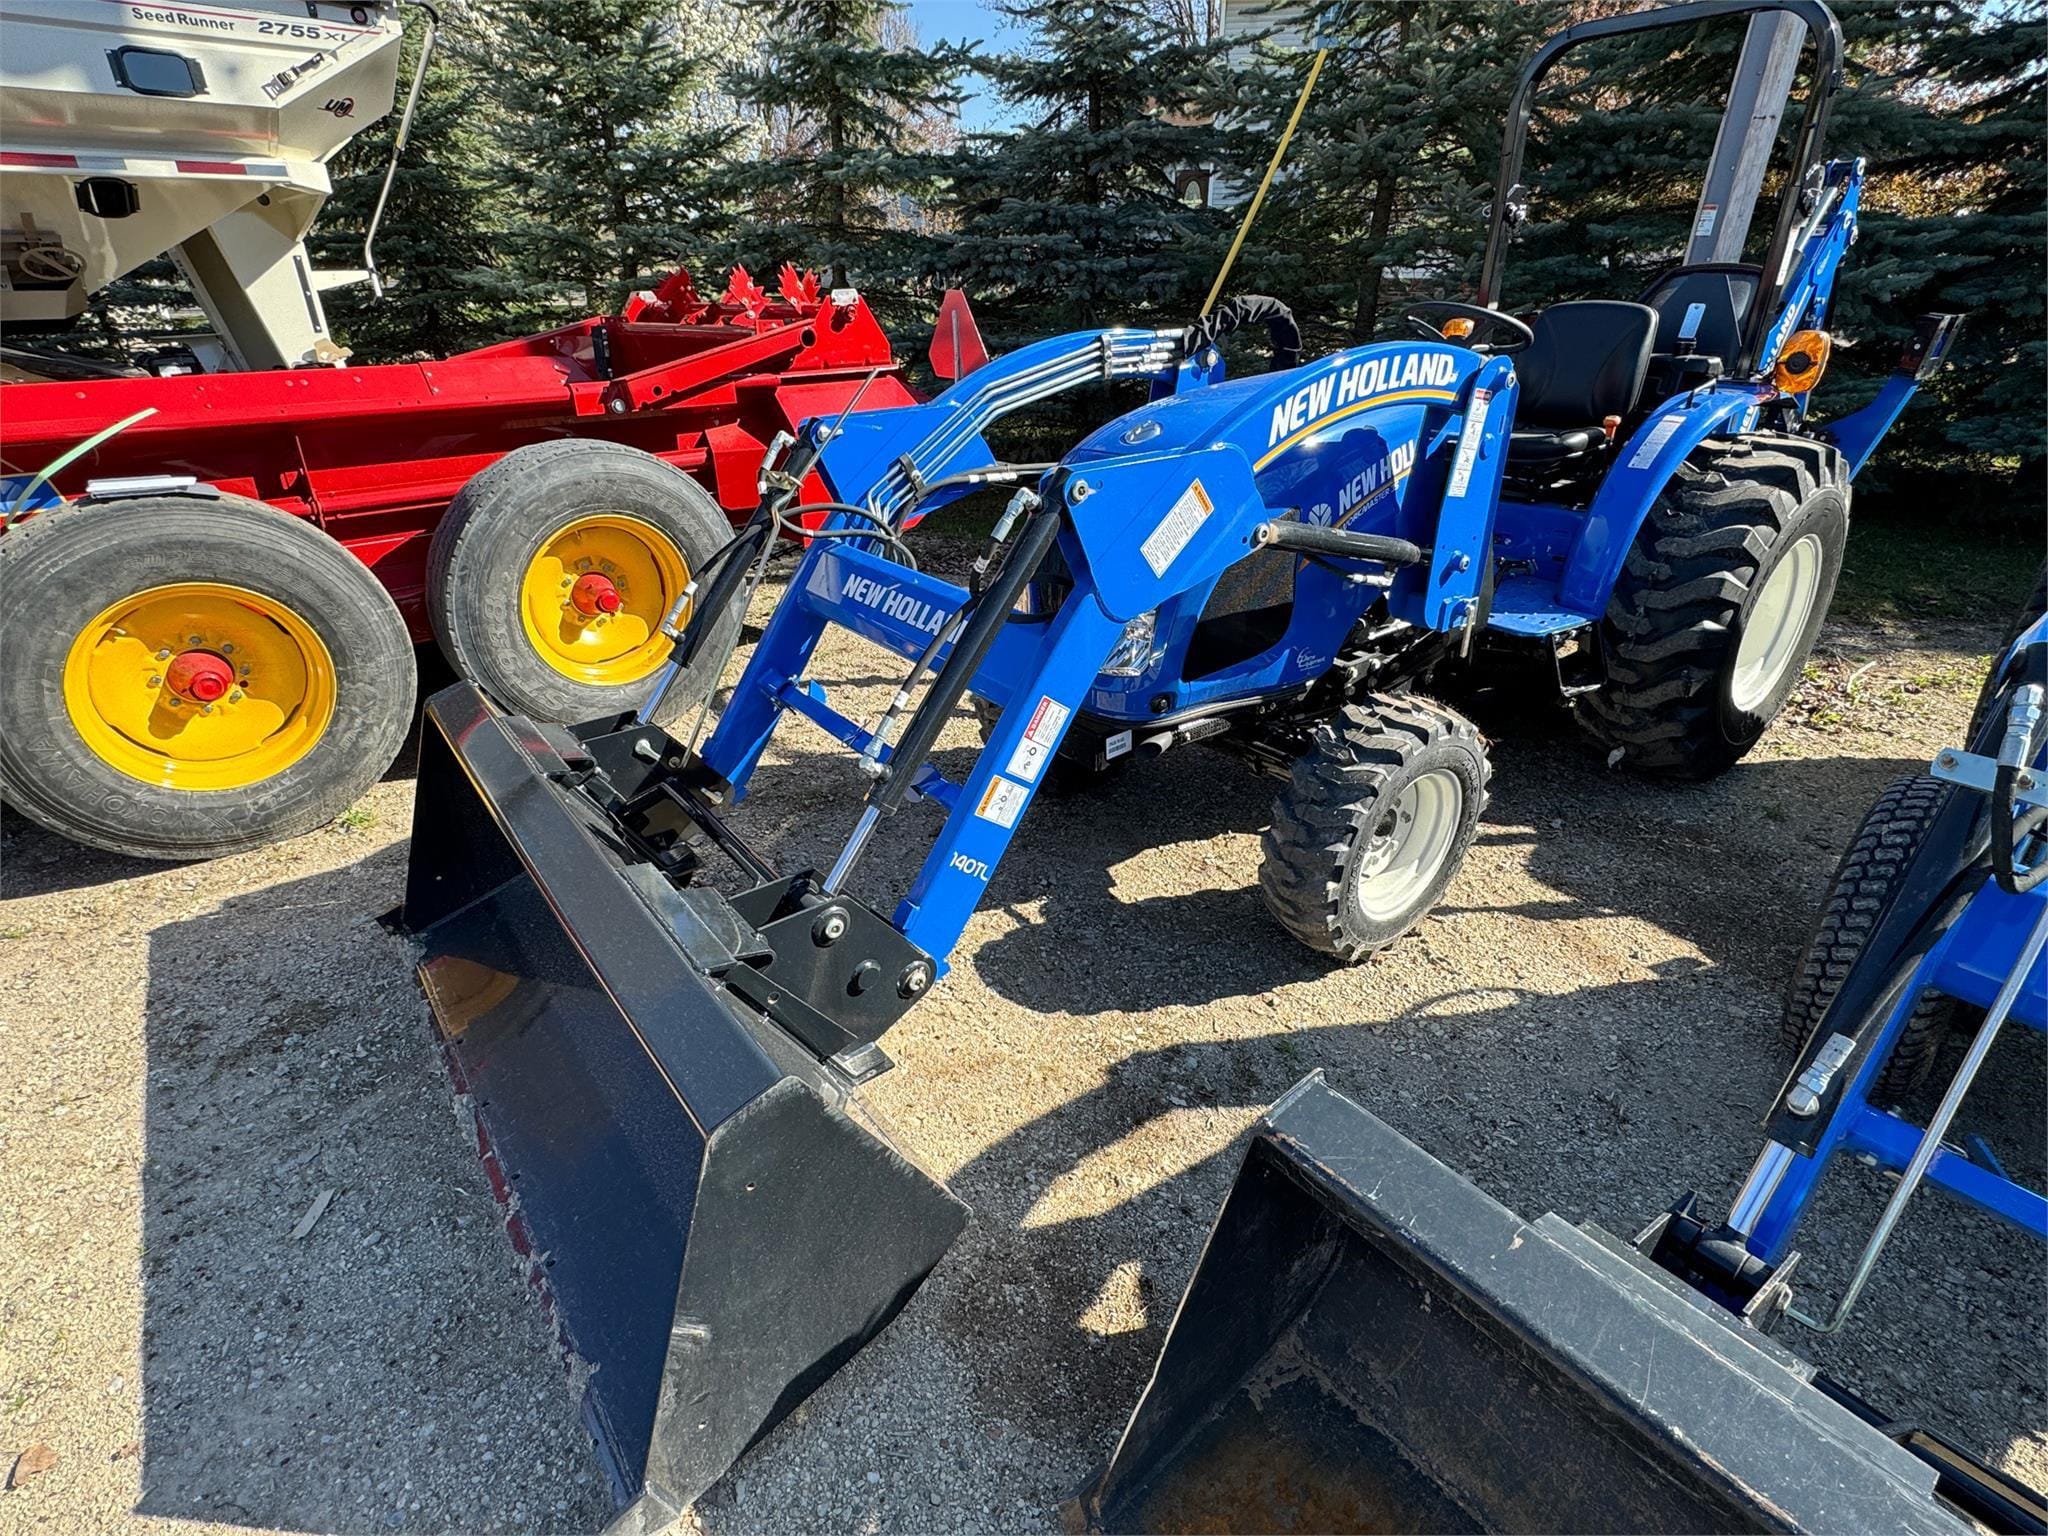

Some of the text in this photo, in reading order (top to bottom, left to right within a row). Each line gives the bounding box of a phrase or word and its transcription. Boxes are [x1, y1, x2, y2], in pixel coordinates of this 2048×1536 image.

[258, 20, 321, 40] 2755
[323, 31, 351, 43] XL
[1268, 352, 1455, 448] NEW HOLLAND
[1339, 462, 1378, 517] NEW
[1379, 438, 1416, 484] HOLL
[842, 573, 969, 646] NEW HOLLAN
[27, 733, 188, 831] YOKOHAMA
[950, 851, 990, 882] 140TL
